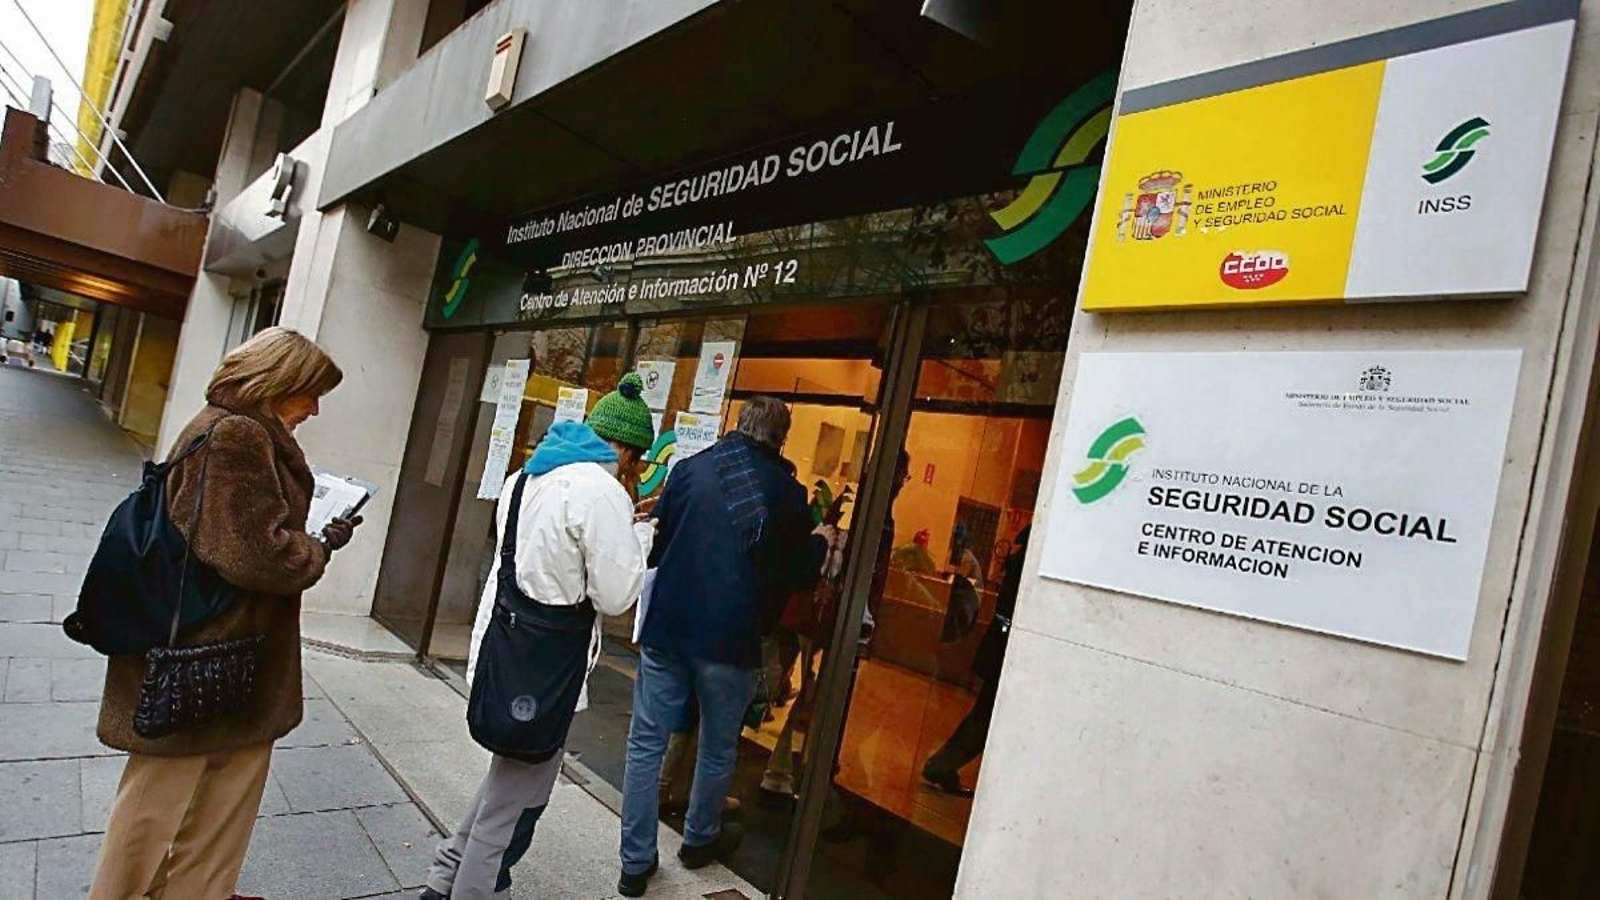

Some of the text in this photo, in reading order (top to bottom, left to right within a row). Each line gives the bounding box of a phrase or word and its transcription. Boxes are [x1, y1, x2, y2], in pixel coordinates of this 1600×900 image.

[507, 121, 902, 244] Instituto Nacional de SEGURIDAD SOCIAL
[1198, 180, 1278, 201] MINISTERIO
[1193, 204, 1347, 228] Y SEGURIDAD SOCIAL
[1195, 196, 1276, 215] DE EMPLEO
[1418, 195, 1472, 215] INSS
[562, 221, 737, 269] DIRECCION PROVINCIAL
[1224, 256, 1286, 275] CCOO
[520, 293, 553, 311] Centro
[554, 291, 569, 307] de
[570, 281, 625, 306] Atención
[628, 286, 637, 300] e
[640, 268, 738, 300] Información
[773, 259, 799, 285] 12
[1152, 468, 1344, 498] INSTITUTO NACIONAL DE LA
[1148, 486, 1457, 543] SEGURIDAD SOCIAL
[1138, 541, 1289, 579] E INFORMACION
[1141, 522, 1362, 569] CENTRO DE ATENCION
